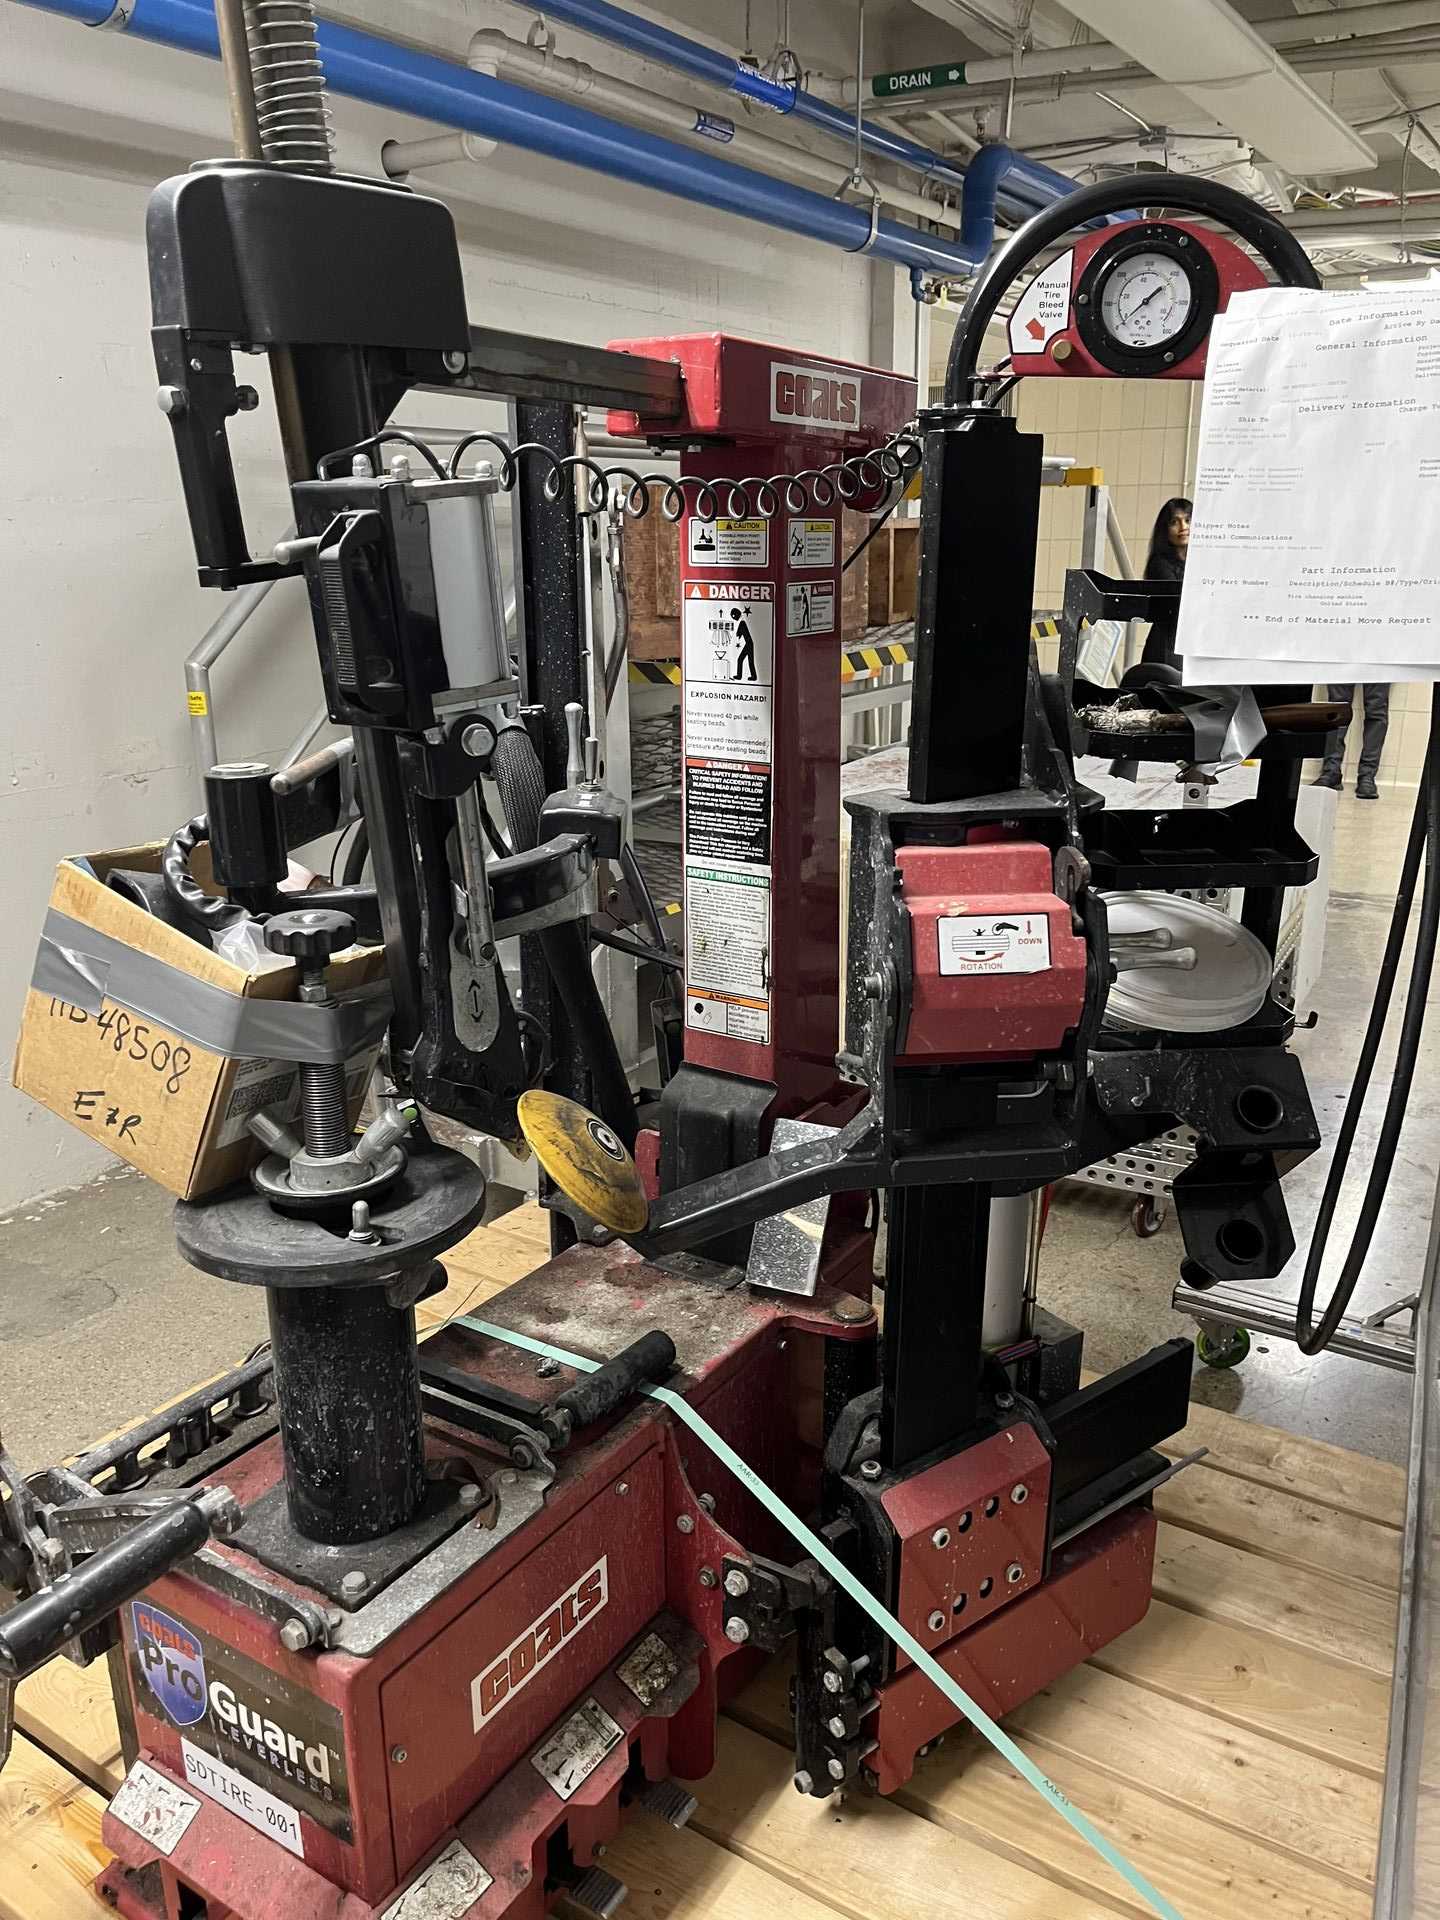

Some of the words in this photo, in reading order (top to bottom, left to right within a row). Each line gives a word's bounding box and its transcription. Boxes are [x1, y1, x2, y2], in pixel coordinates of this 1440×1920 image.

[889, 72, 931, 90] DRAIN
[1037, 281, 1069, 289] Manual
[1044, 291, 1060, 299] Tire
[1329, 317, 1352, 326] Date
[1359, 310, 1422, 321] Information
[1315, 341, 1356, 351] General
[1363, 335, 1428, 348] Information
[1298, 404, 1345, 413] Delivery
[1351, 398, 1416, 409] Information
[1399, 405, 1427, 413] Charge
[1331, 566, 1396, 574] Information
[709, 585, 771, 600] DANGER
[1305, 616, 1352, 624] Material
[1388, 617, 1432, 625] Request
[690, 691, 732, 700] EXPLOSION
[734, 694, 767, 702] HAZARD!
[704, 711, 724, 719] exceed
[733, 713, 742, 721] psi
[725, 738, 767, 747] recommended
[726, 745, 747, 754] seating
[712, 761, 743, 771] DANGER
[689, 768, 711, 776] CRITICAL
[692, 781, 715, 789] INJURIES
[742, 786, 763, 794] FOLLOW
[700, 776, 722, 784] PREVENT
[723, 778, 751, 787] ACCIDENTS
[752, 780, 763, 788] AND
[687, 866, 714, 880] SAFETY
[715, 871, 769, 886] INSTRUCTIONS
[960, 962, 1003, 971] ROTATION
[715, 994, 741, 1003] WARNING
[143, 1634, 203, 1702] Pro
[208, 1681, 331, 1785] Guard
[568, 1735, 586, 1758] STOP
[581, 1752, 602, 1775] DOWN
[185, 1753, 299, 1840] SDTIRE-001
